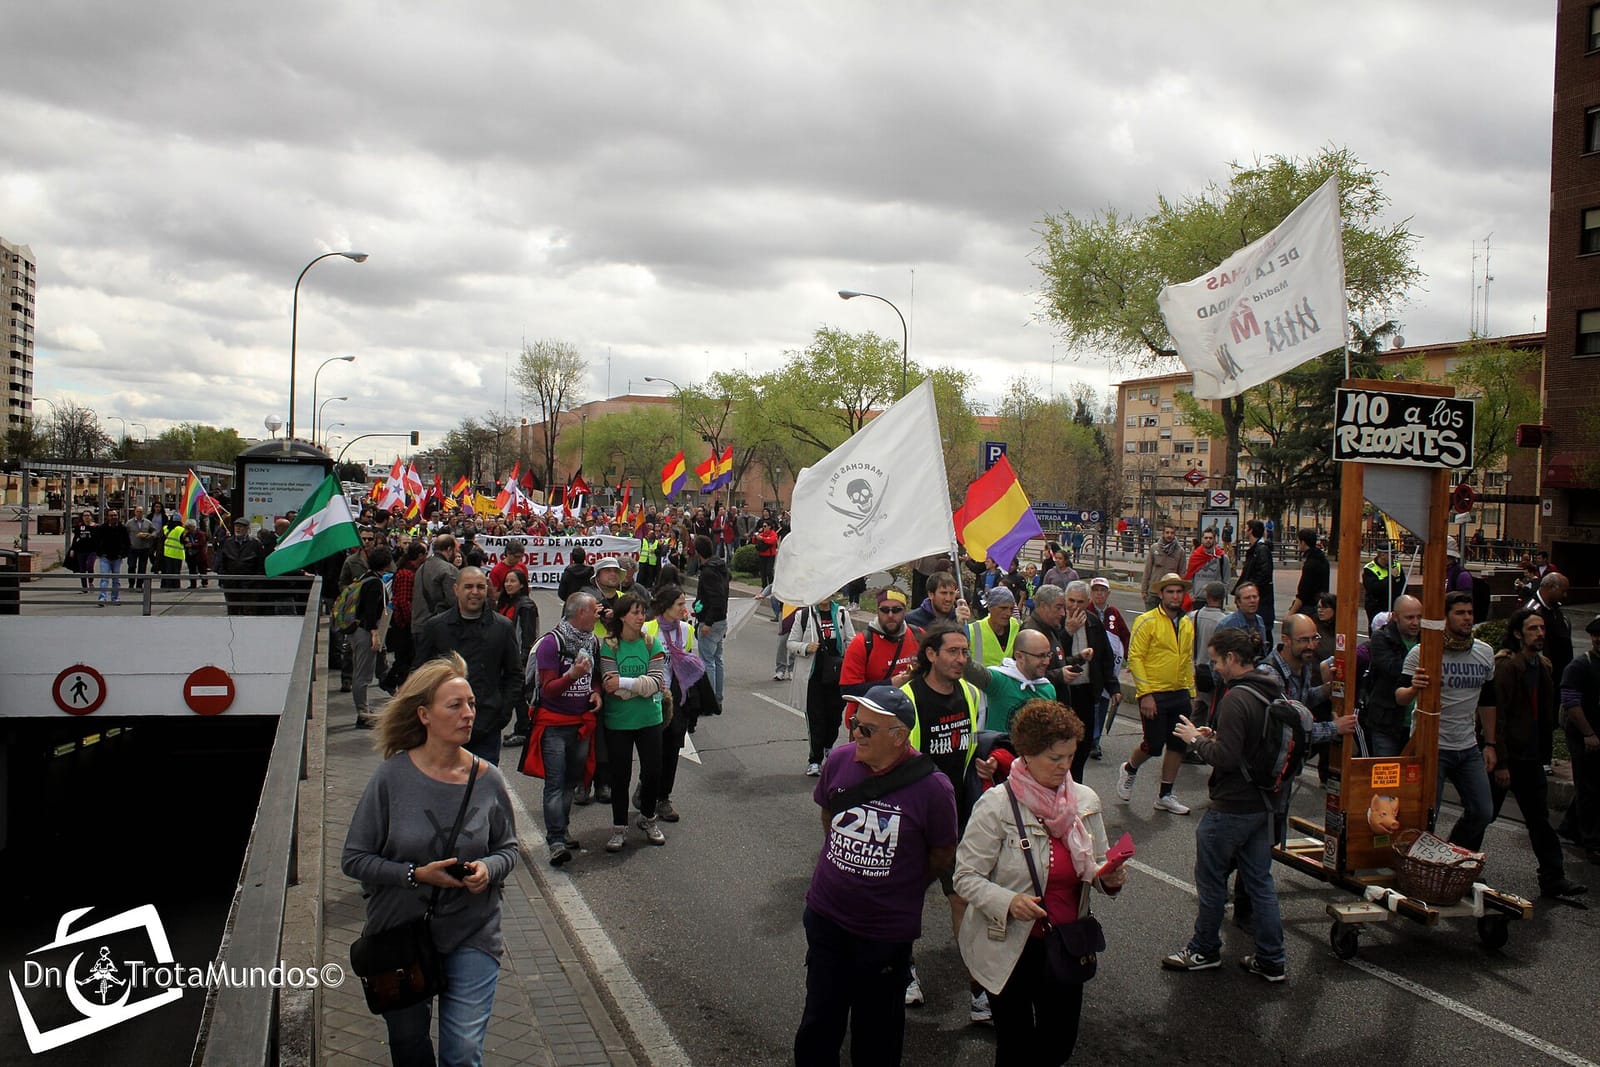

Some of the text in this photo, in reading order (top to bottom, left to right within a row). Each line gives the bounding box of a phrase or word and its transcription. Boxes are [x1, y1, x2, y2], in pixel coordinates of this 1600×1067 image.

[1404, 407, 1422, 423] a
[1429, 399, 1464, 428] los
[1336, 424, 1467, 466] RECORTES
[990, 446, 1002, 461] P
[485, 537, 604, 547] MADD 22 DE MARZO
[543, 552, 565, 566] LA
[621, 664, 645, 673] STOP
[930, 725, 940, 733] DE
[941, 723, 950, 731] LA
[830, 829, 895, 858] MARCHAS
[844, 851, 892, 867] DIGNIDAD
[862, 869, 890, 878] Madrid
